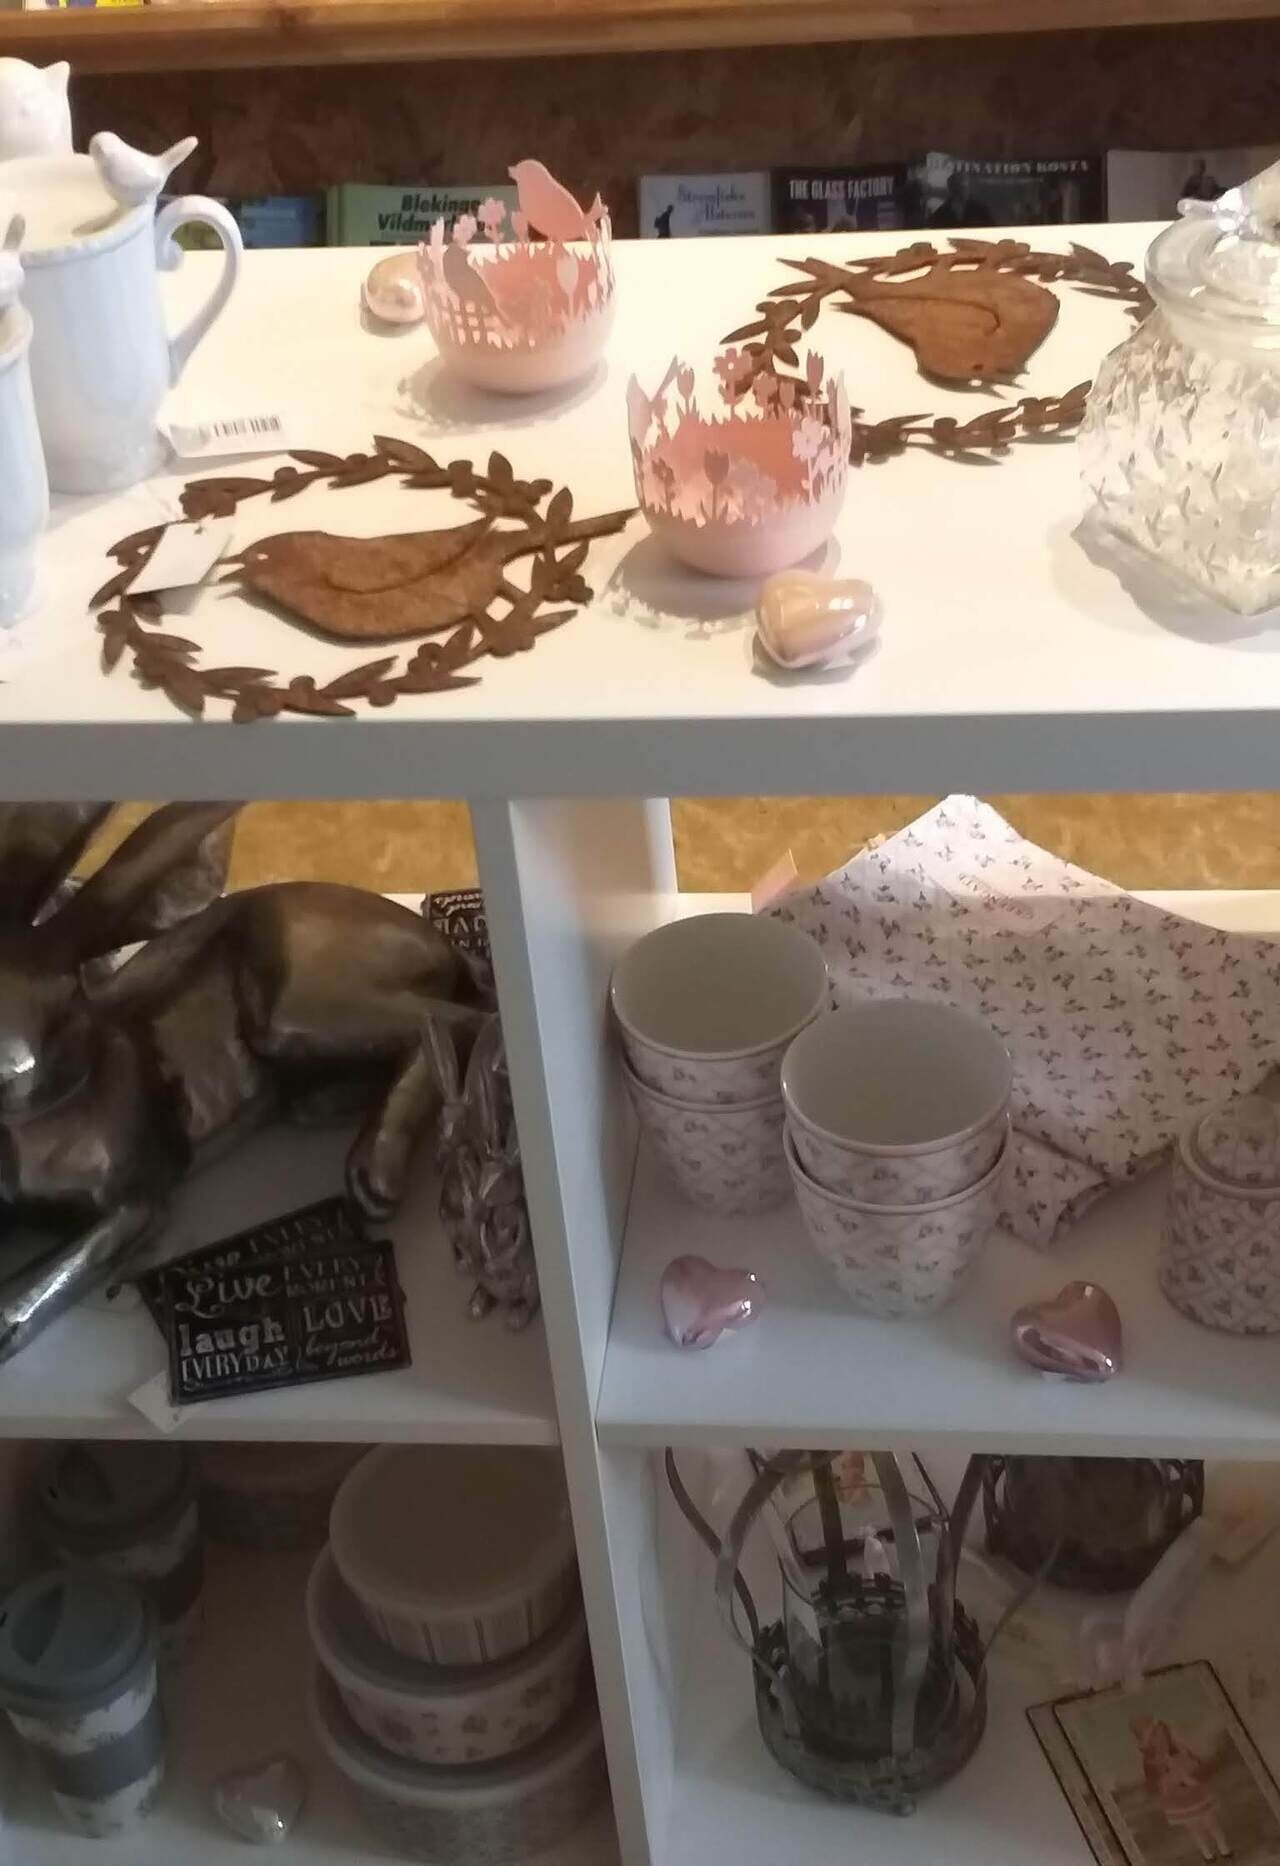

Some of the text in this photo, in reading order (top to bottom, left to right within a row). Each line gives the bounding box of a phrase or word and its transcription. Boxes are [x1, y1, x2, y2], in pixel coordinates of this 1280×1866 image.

[789, 176, 895, 200] THE GLASS FACTORY
[174, 1272, 280, 1319] Live
[303, 1294, 394, 1334] LOVE
[178, 1316, 286, 1358] laugh
